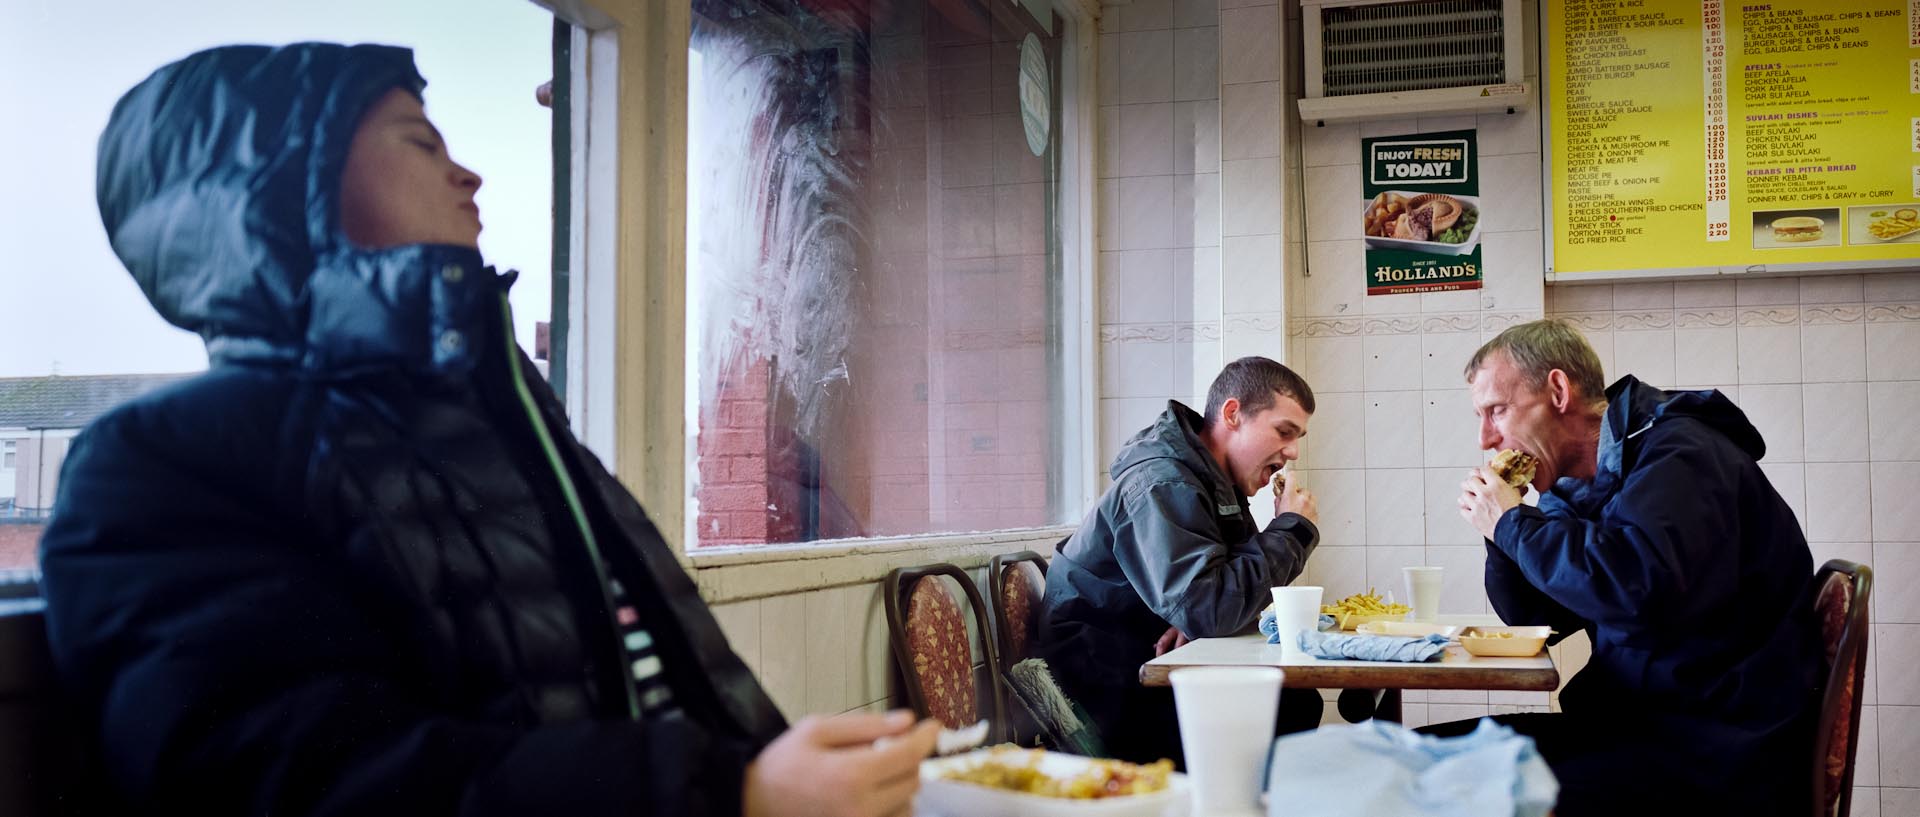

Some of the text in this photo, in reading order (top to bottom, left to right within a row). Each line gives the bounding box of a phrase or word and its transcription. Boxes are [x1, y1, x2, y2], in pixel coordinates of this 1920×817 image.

[1598, 15, 1636, 23] BARBECUE
[1596, 65, 1631, 73] BATTERED
[1634, 62, 1670, 70] SAUSAGE
[1567, 74, 1601, 82] BATTERED
[1611, 141, 1656, 150] MUSHROOM
[1377, 148, 1461, 160] ENJOY FRESH
[1386, 163, 1451, 177] TODAY!
